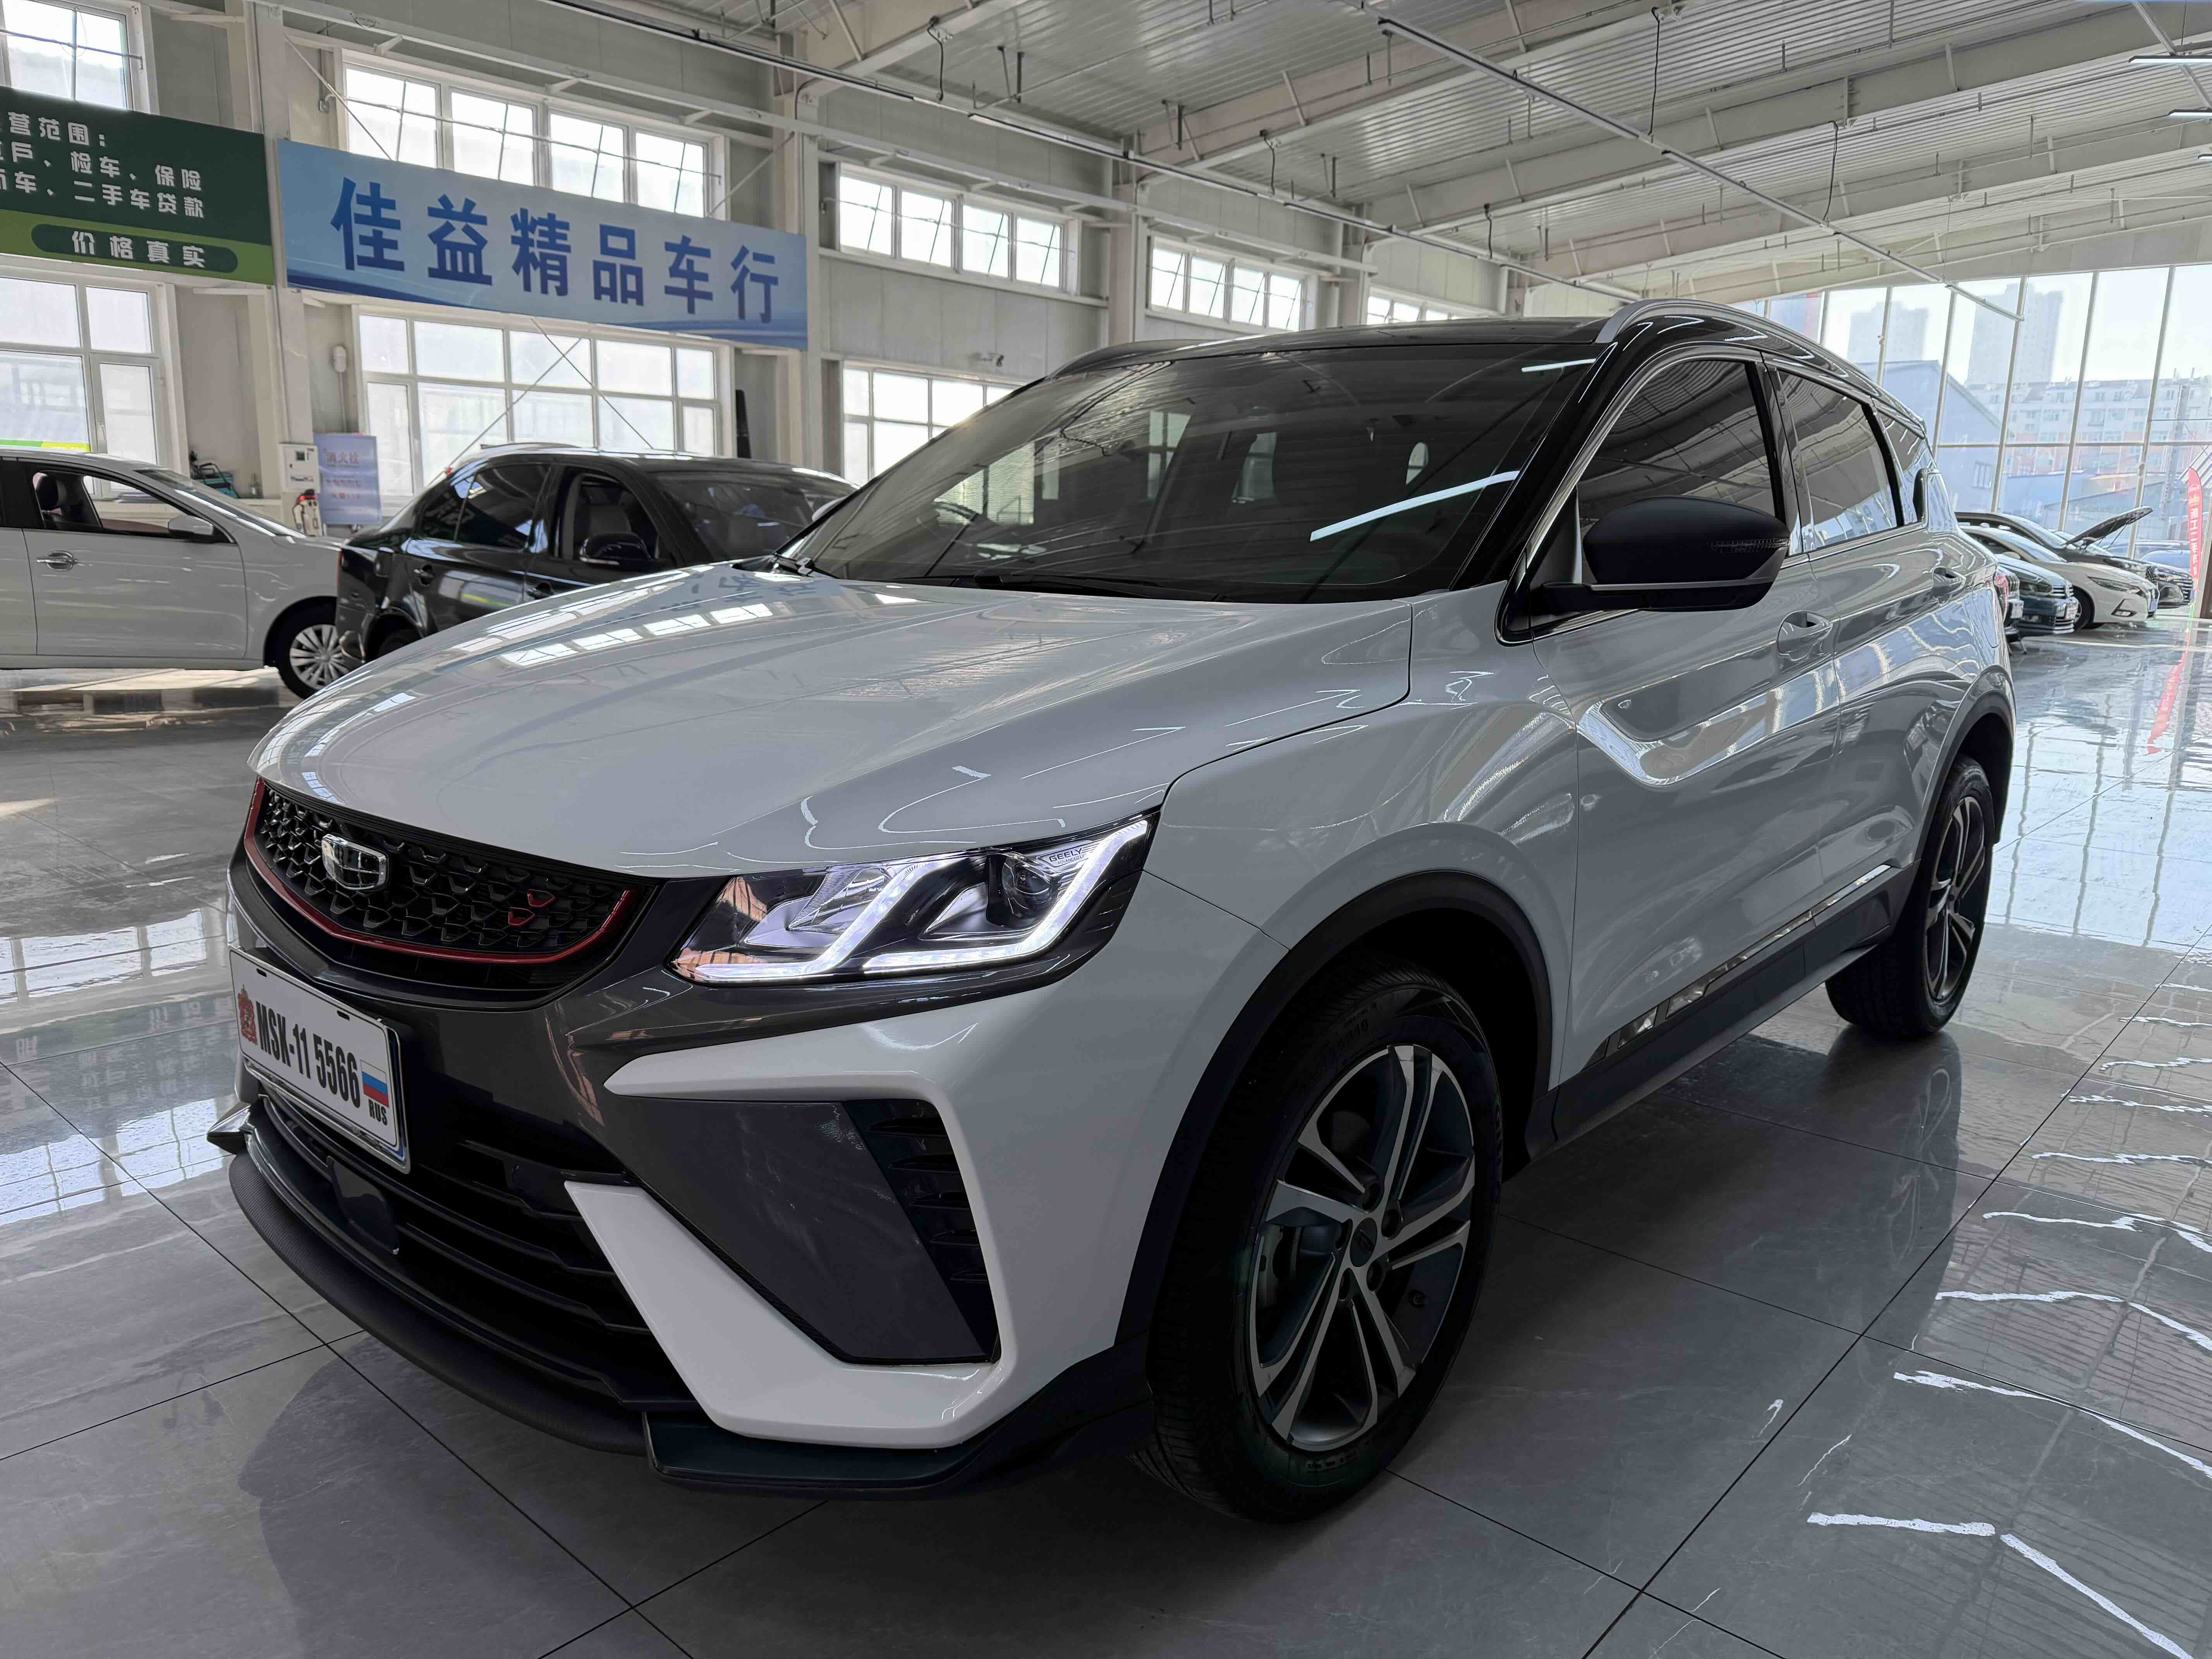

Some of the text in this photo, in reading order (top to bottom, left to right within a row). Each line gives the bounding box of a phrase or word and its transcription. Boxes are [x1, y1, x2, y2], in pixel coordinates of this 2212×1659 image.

[0, 112, 105, 147] 营范围：
[0, 141, 202, 191] 户、检车、保险
[72, 231, 205, 268] 价格真实
[330, 176, 779, 324] 佳益精品车行
[1049, 848, 1082, 862] GEELY
[256, 1001, 360, 1108] MSK-11 5566
[368, 1099, 388, 1125] RUS
